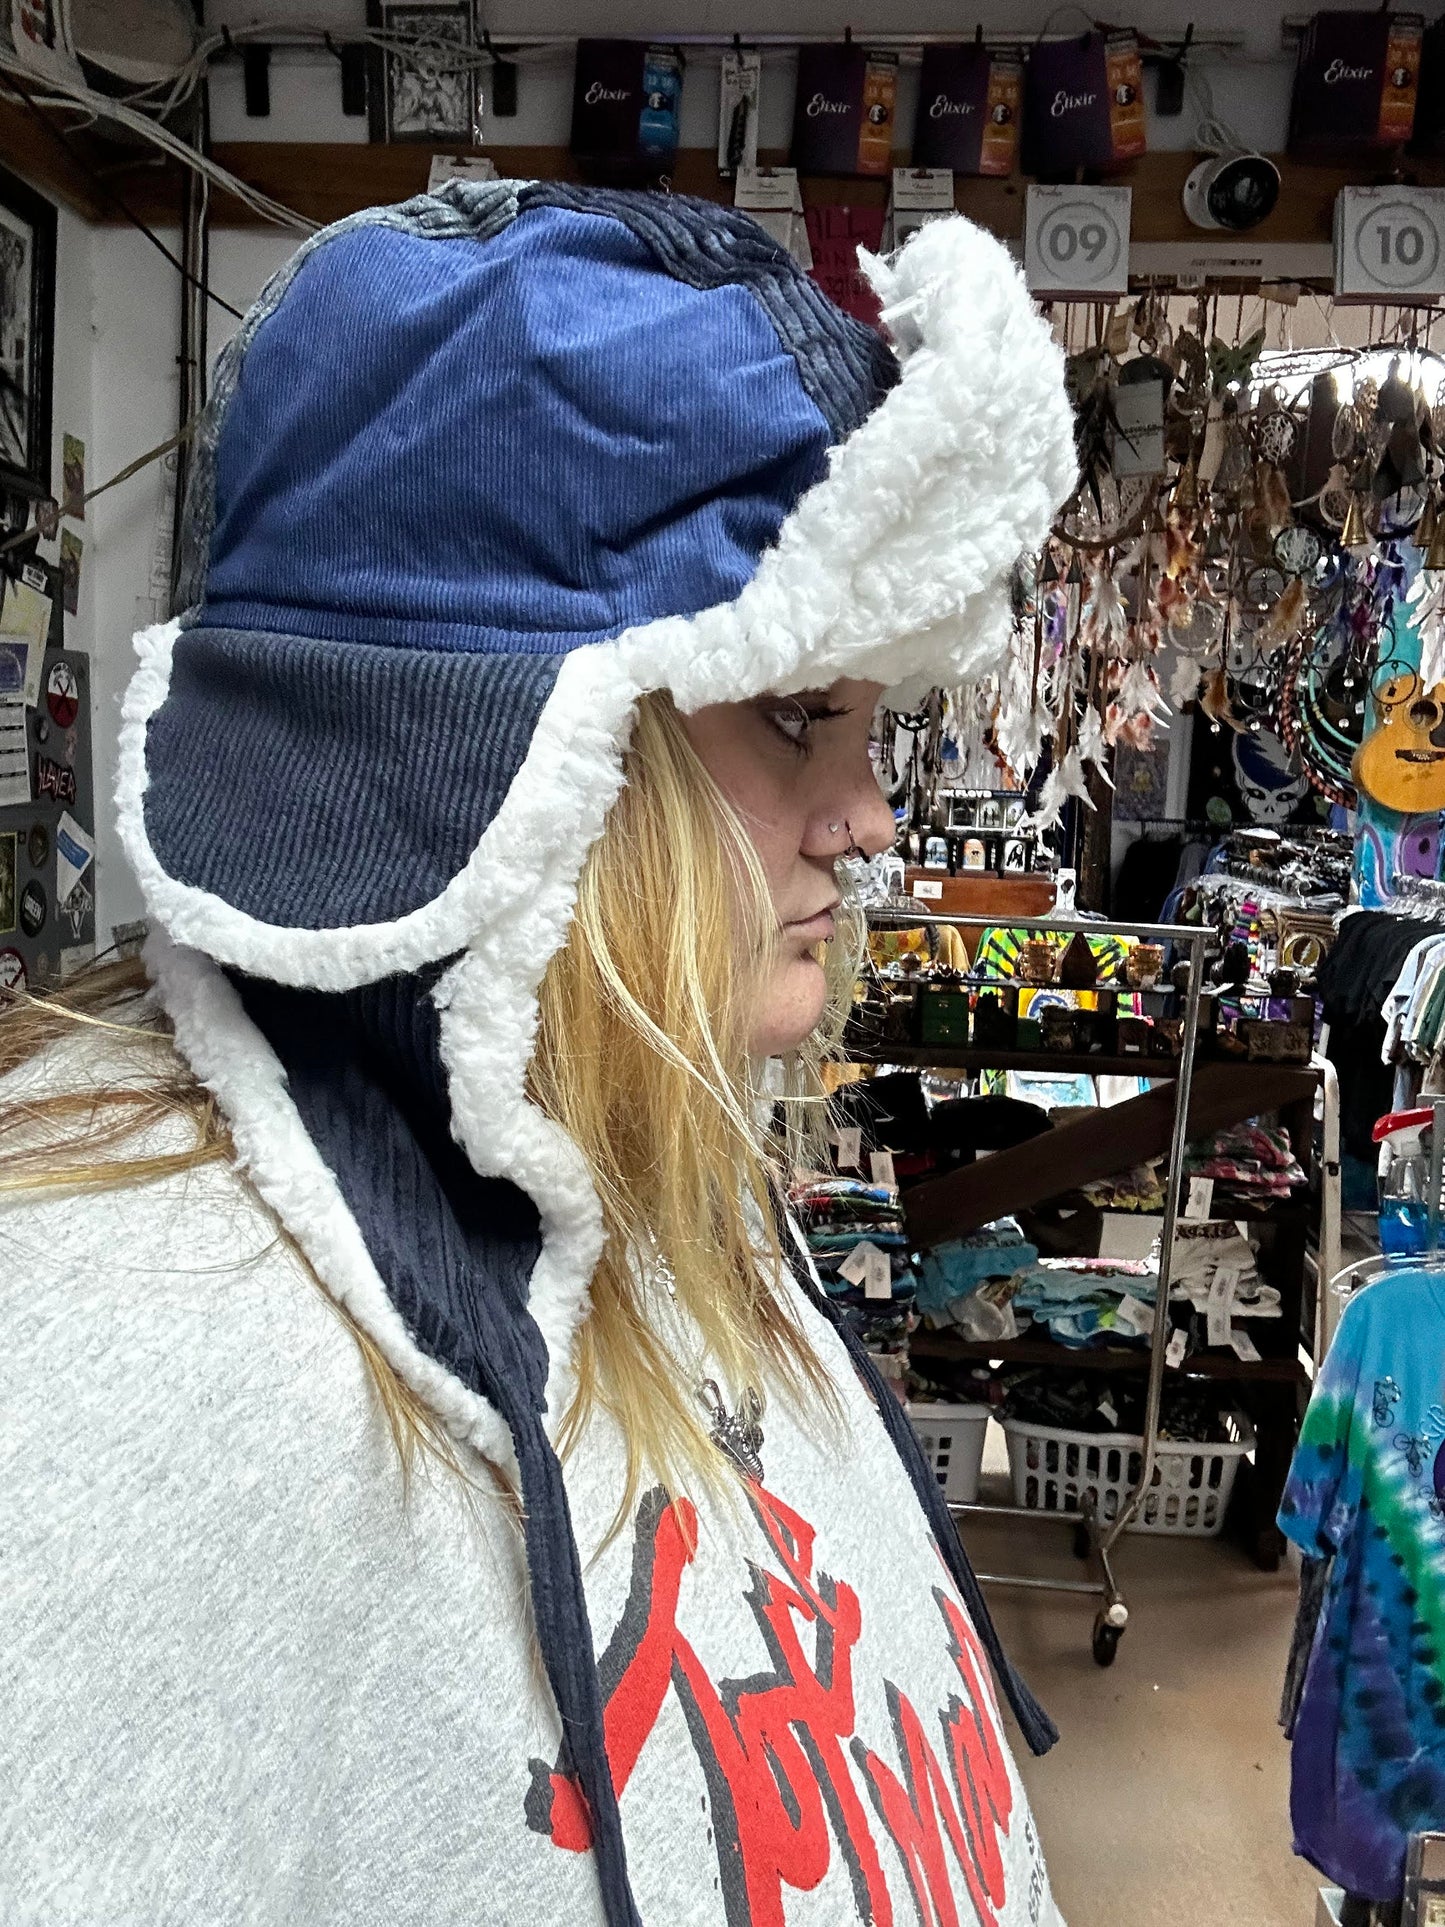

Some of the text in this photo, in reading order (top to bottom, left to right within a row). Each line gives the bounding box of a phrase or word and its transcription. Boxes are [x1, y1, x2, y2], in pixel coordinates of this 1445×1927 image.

[1323, 58, 1374, 84] Elixir
[584, 81, 633, 105] Elixir
[806, 92, 852, 117] Elixir
[929, 94, 975, 118] Elixir
[1050, 90, 1097, 118] Elixir
[1049, 222, 1108, 263] 09
[1376, 225, 1425, 266] 10
[37, 753, 77, 803] SLAYER
[955, 788, 993, 799] FLOYD
